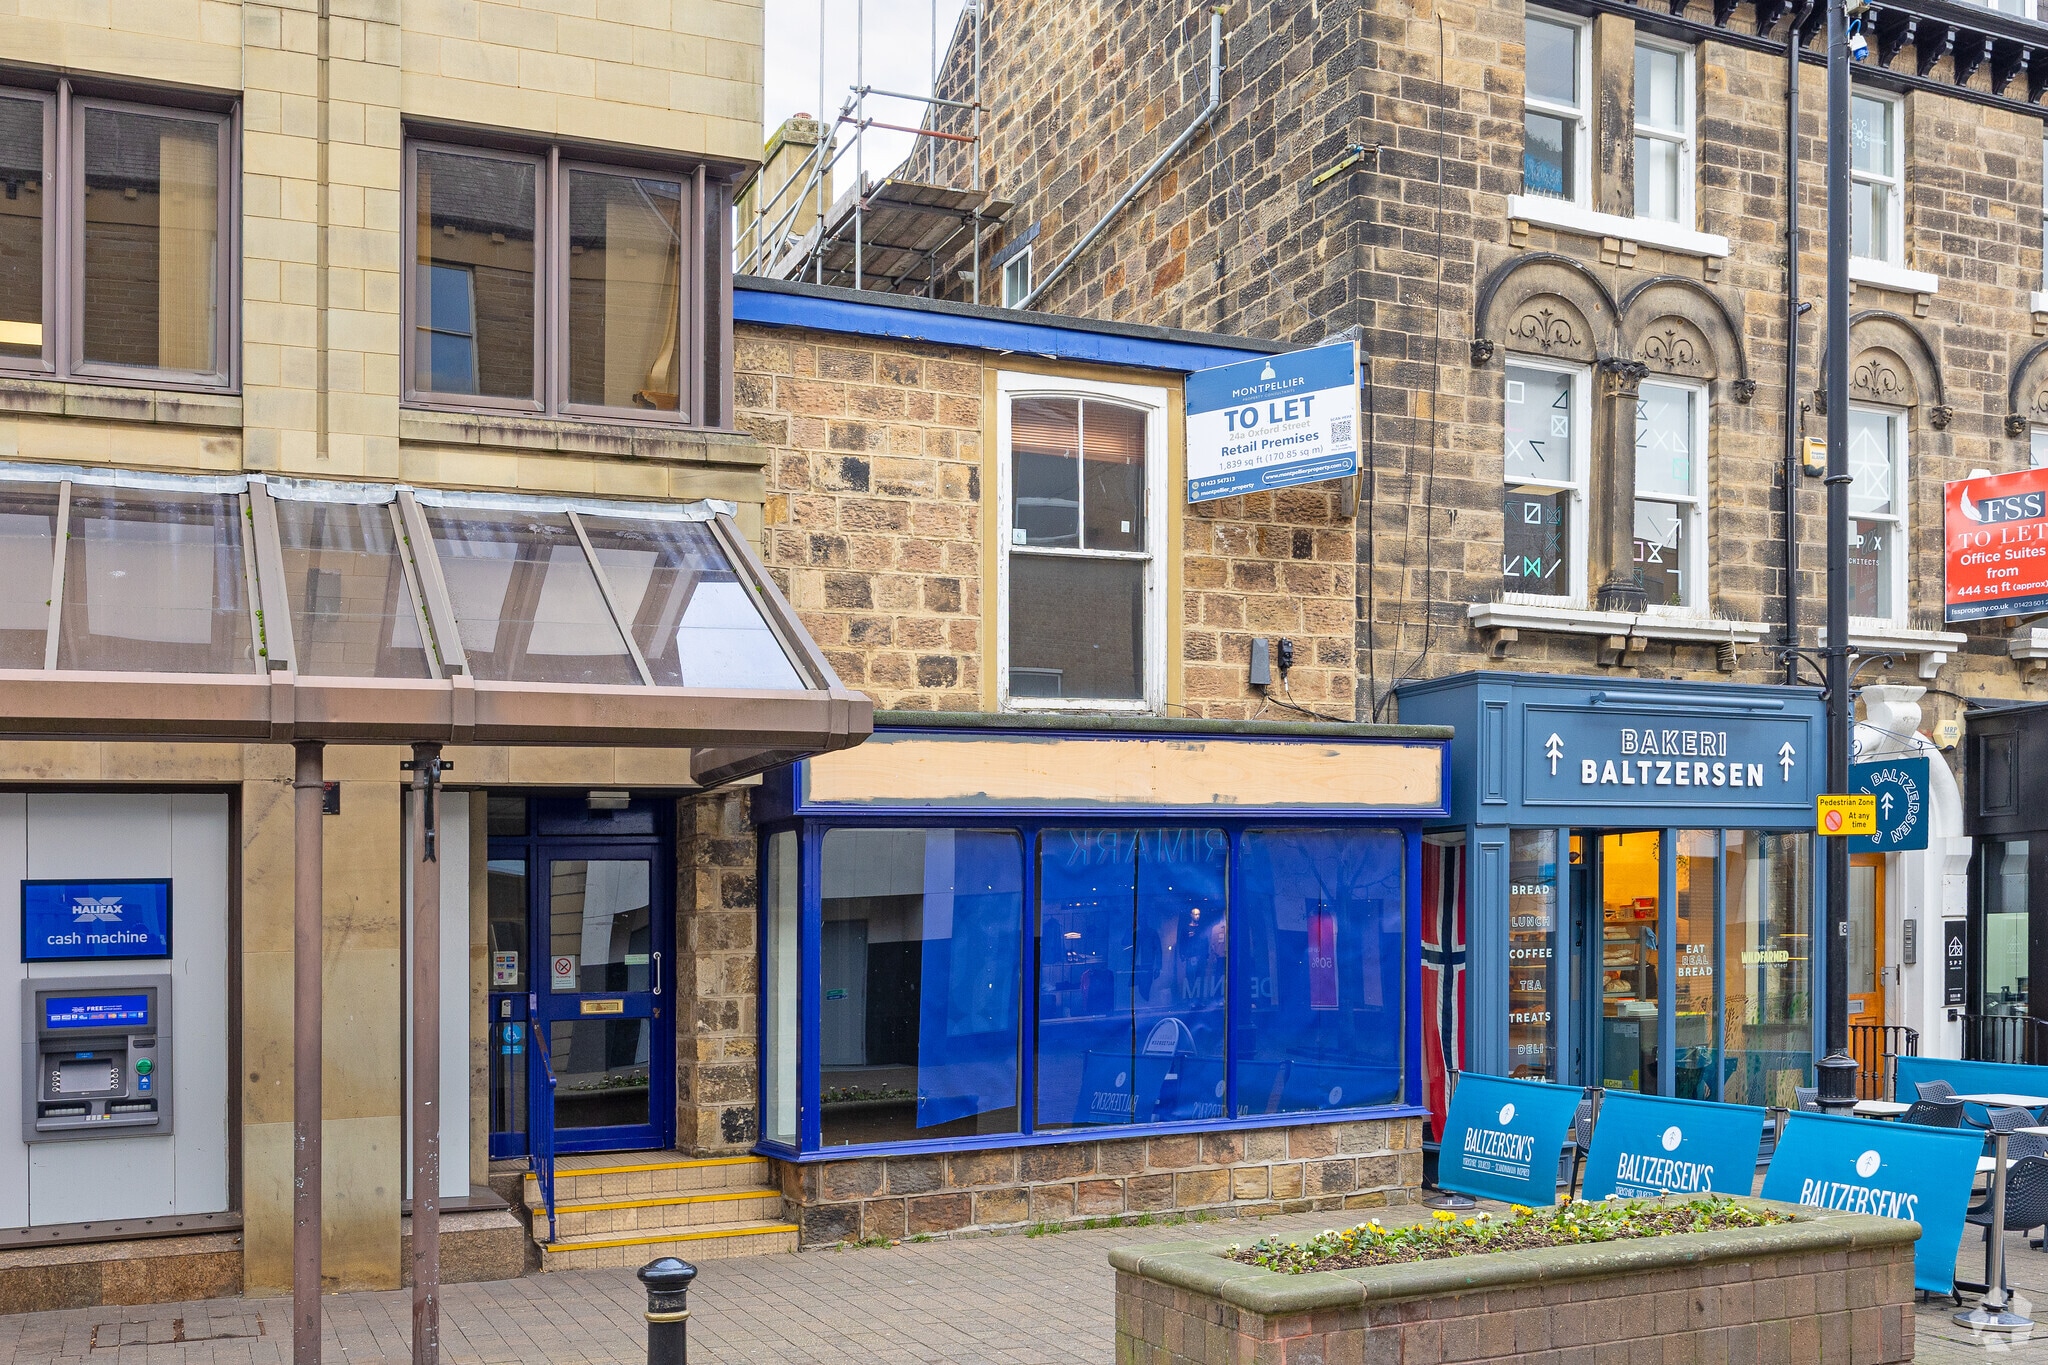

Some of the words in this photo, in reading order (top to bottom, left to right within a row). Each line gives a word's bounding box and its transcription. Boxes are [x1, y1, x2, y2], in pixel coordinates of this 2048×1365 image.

[1232, 377, 1305, 398] MONTPELLIER
[1224, 406, 1259, 432] TO
[1269, 395, 1315, 424] LET
[1229, 431, 1246, 442] 24a
[1247, 425, 1280, 438] Oxford
[1282, 419, 1311, 432] Street
[1221, 440, 1257, 457] Retail
[1261, 431, 1319, 450] Premises
[1219, 457, 1243, 471] 1,839
[1243, 459, 1254, 468] sq
[1256, 454, 1264, 464] ft
[1265, 449, 1298, 464] (170.85
[1299, 450, 1310, 459] sq
[1311, 444, 1324, 456] m)
[1265, 463, 1342, 480] www.montpellierproperty.com
[1984, 493, 2042, 524] FSS
[1958, 530, 1992, 549] TO
[2001, 522, 2048, 545] LET
[1849, 557, 1880, 566] CHITECTS
[1960, 550, 2001, 565] Office
[2004, 546, 2046, 561] Suites
[1986, 566, 2019, 579] from
[1957, 585, 1981, 597] 444
[1984, 585, 1998, 594] sq
[2001, 581, 2011, 592] ft
[2012, 579, 2048, 591] (approx)
[1951, 602, 2009, 615] fssproperty.co.uk
[1620, 728, 1727, 757] BAKERI
[1581, 759, 1764, 787] BALTZERSEN
[1820, 798, 1857, 806] Pedestrian
[1858, 798, 1874, 806] Zone
[1870, 768, 1920, 843] BALTZERSEN
[1852, 820, 1867, 828] time
[1858, 813, 1870, 821] any
[1511, 885, 1550, 895] BREAD
[72, 904, 123, 915] HALIFAX
[1511, 916, 1551, 928] LUNCH
[47, 931, 81, 946] cash
[86, 930, 148, 945] machine
[1509, 948, 1553, 959] COFFEE
[1686, 944, 1705, 954] EAT
[1682, 955, 1709, 965] REAL
[1741, 950, 1789, 964] WILDFARMED
[1678, 966, 1713, 977] BREAD
[1520, 979, 1542, 991] TEA
[1509, 1011, 1551, 1023] TREATS
[1517, 1043, 1544, 1055] DELI
[1464, 1127, 1535, 1163] BALTZERSEN'S
[1616, 1152, 1714, 1193] BALTZERSEN'S
[1800, 1178, 1919, 1221] BALTZERSEN'S
